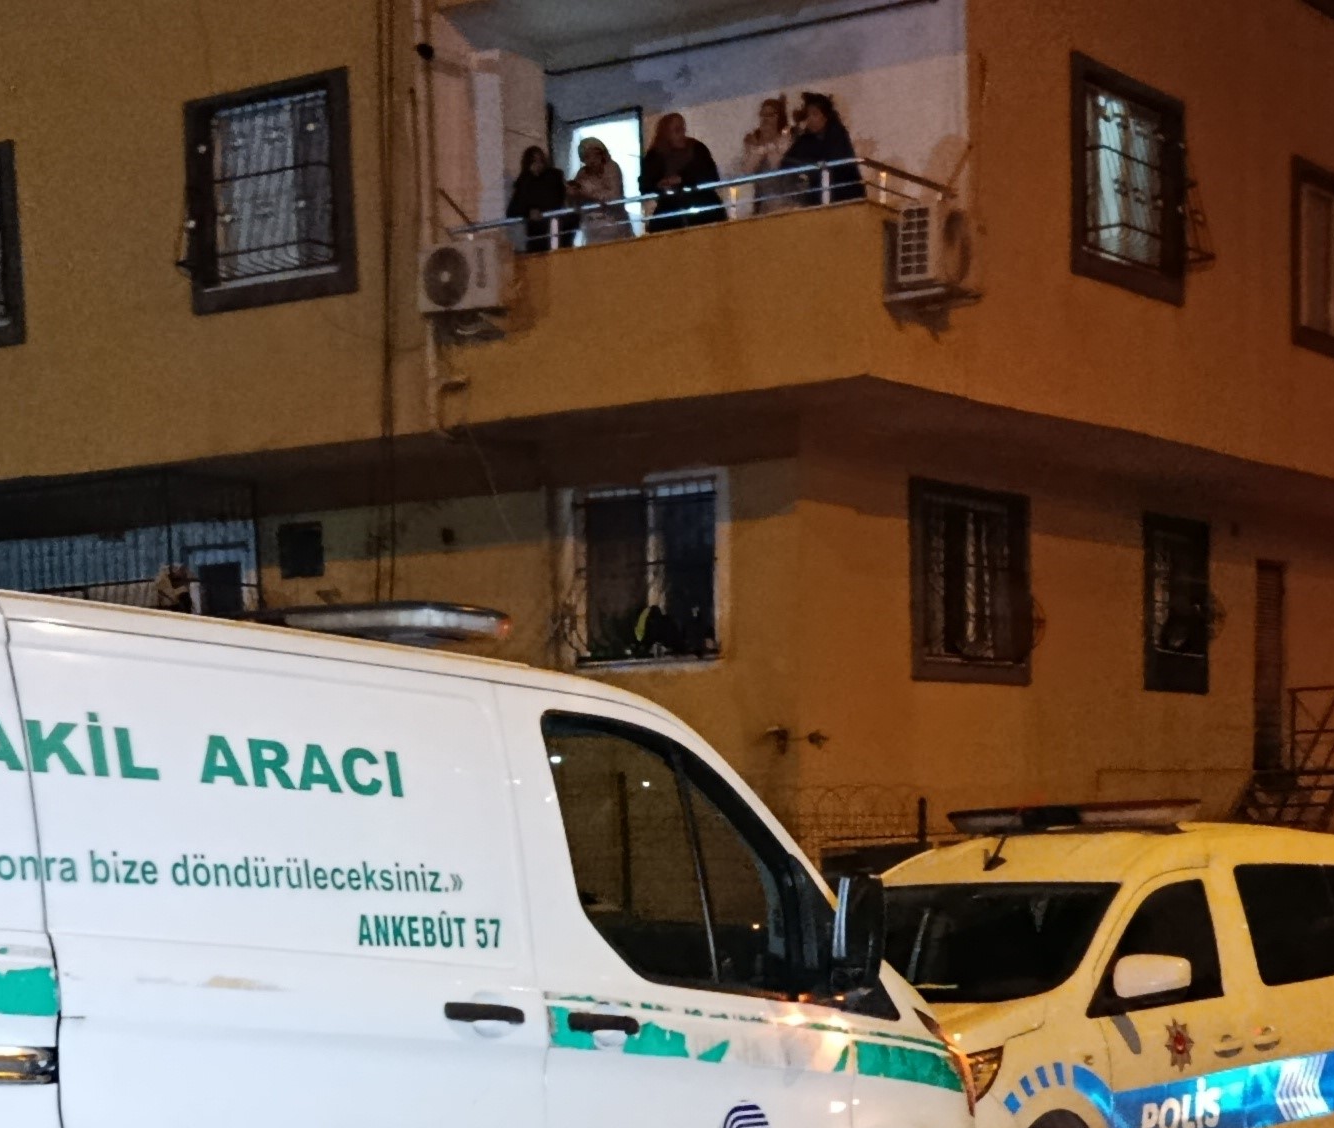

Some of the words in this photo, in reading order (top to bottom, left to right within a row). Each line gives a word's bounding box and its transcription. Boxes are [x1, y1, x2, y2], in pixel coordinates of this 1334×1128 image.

[201, 735, 404, 798] ARACI
[91, 849, 159, 886] bize
[358, 912, 468, 948] ANKEBÛT
[475, 918, 501, 949] 57
